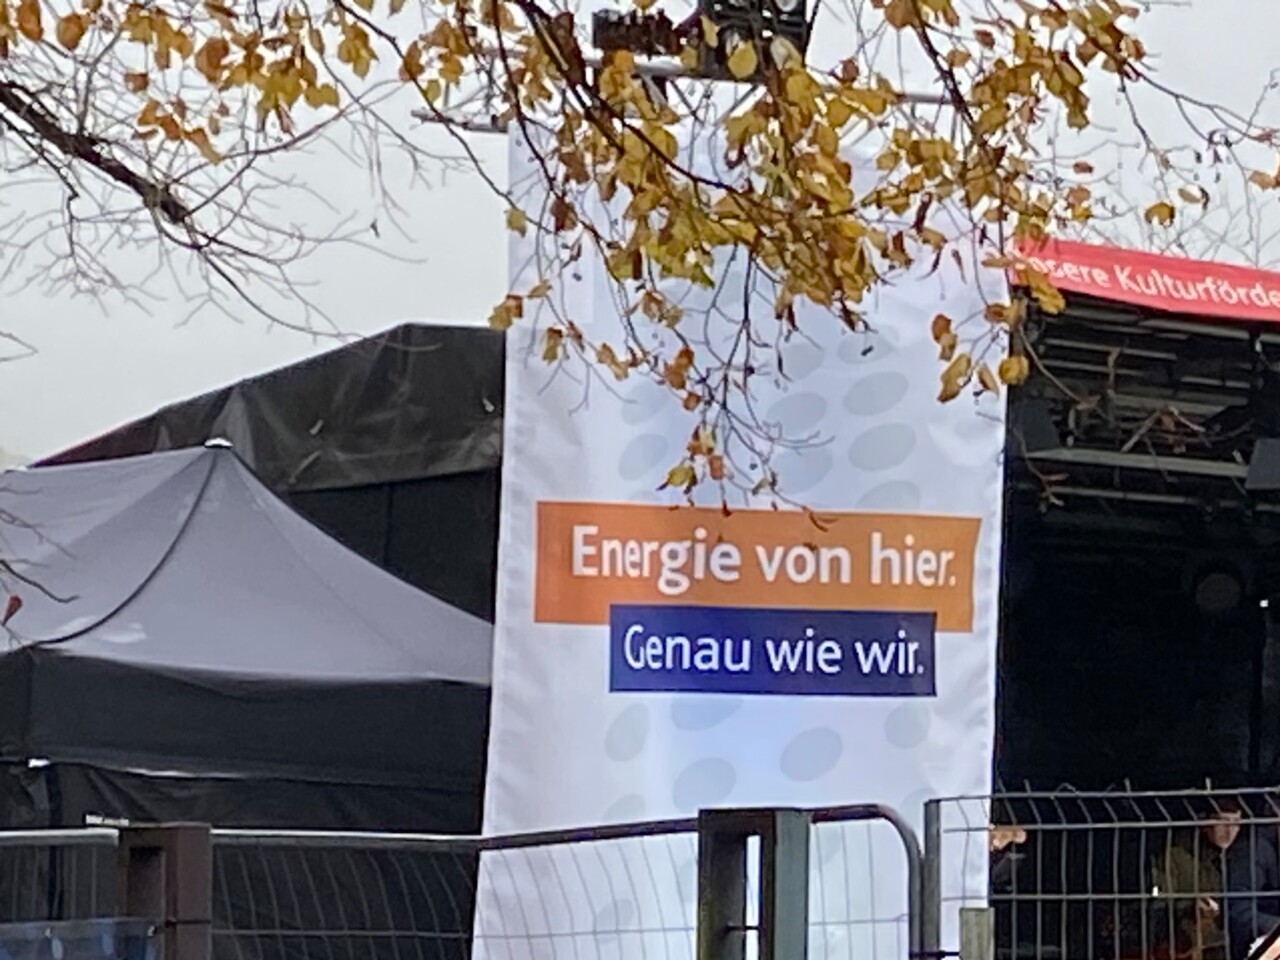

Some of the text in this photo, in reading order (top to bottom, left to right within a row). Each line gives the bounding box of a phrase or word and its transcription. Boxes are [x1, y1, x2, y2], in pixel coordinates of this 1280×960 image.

[1014, 249, 1112, 289] nsere
[572, 525, 957, 595] Energie von hier.
[623, 624, 925, 675] Genau wie wir.
